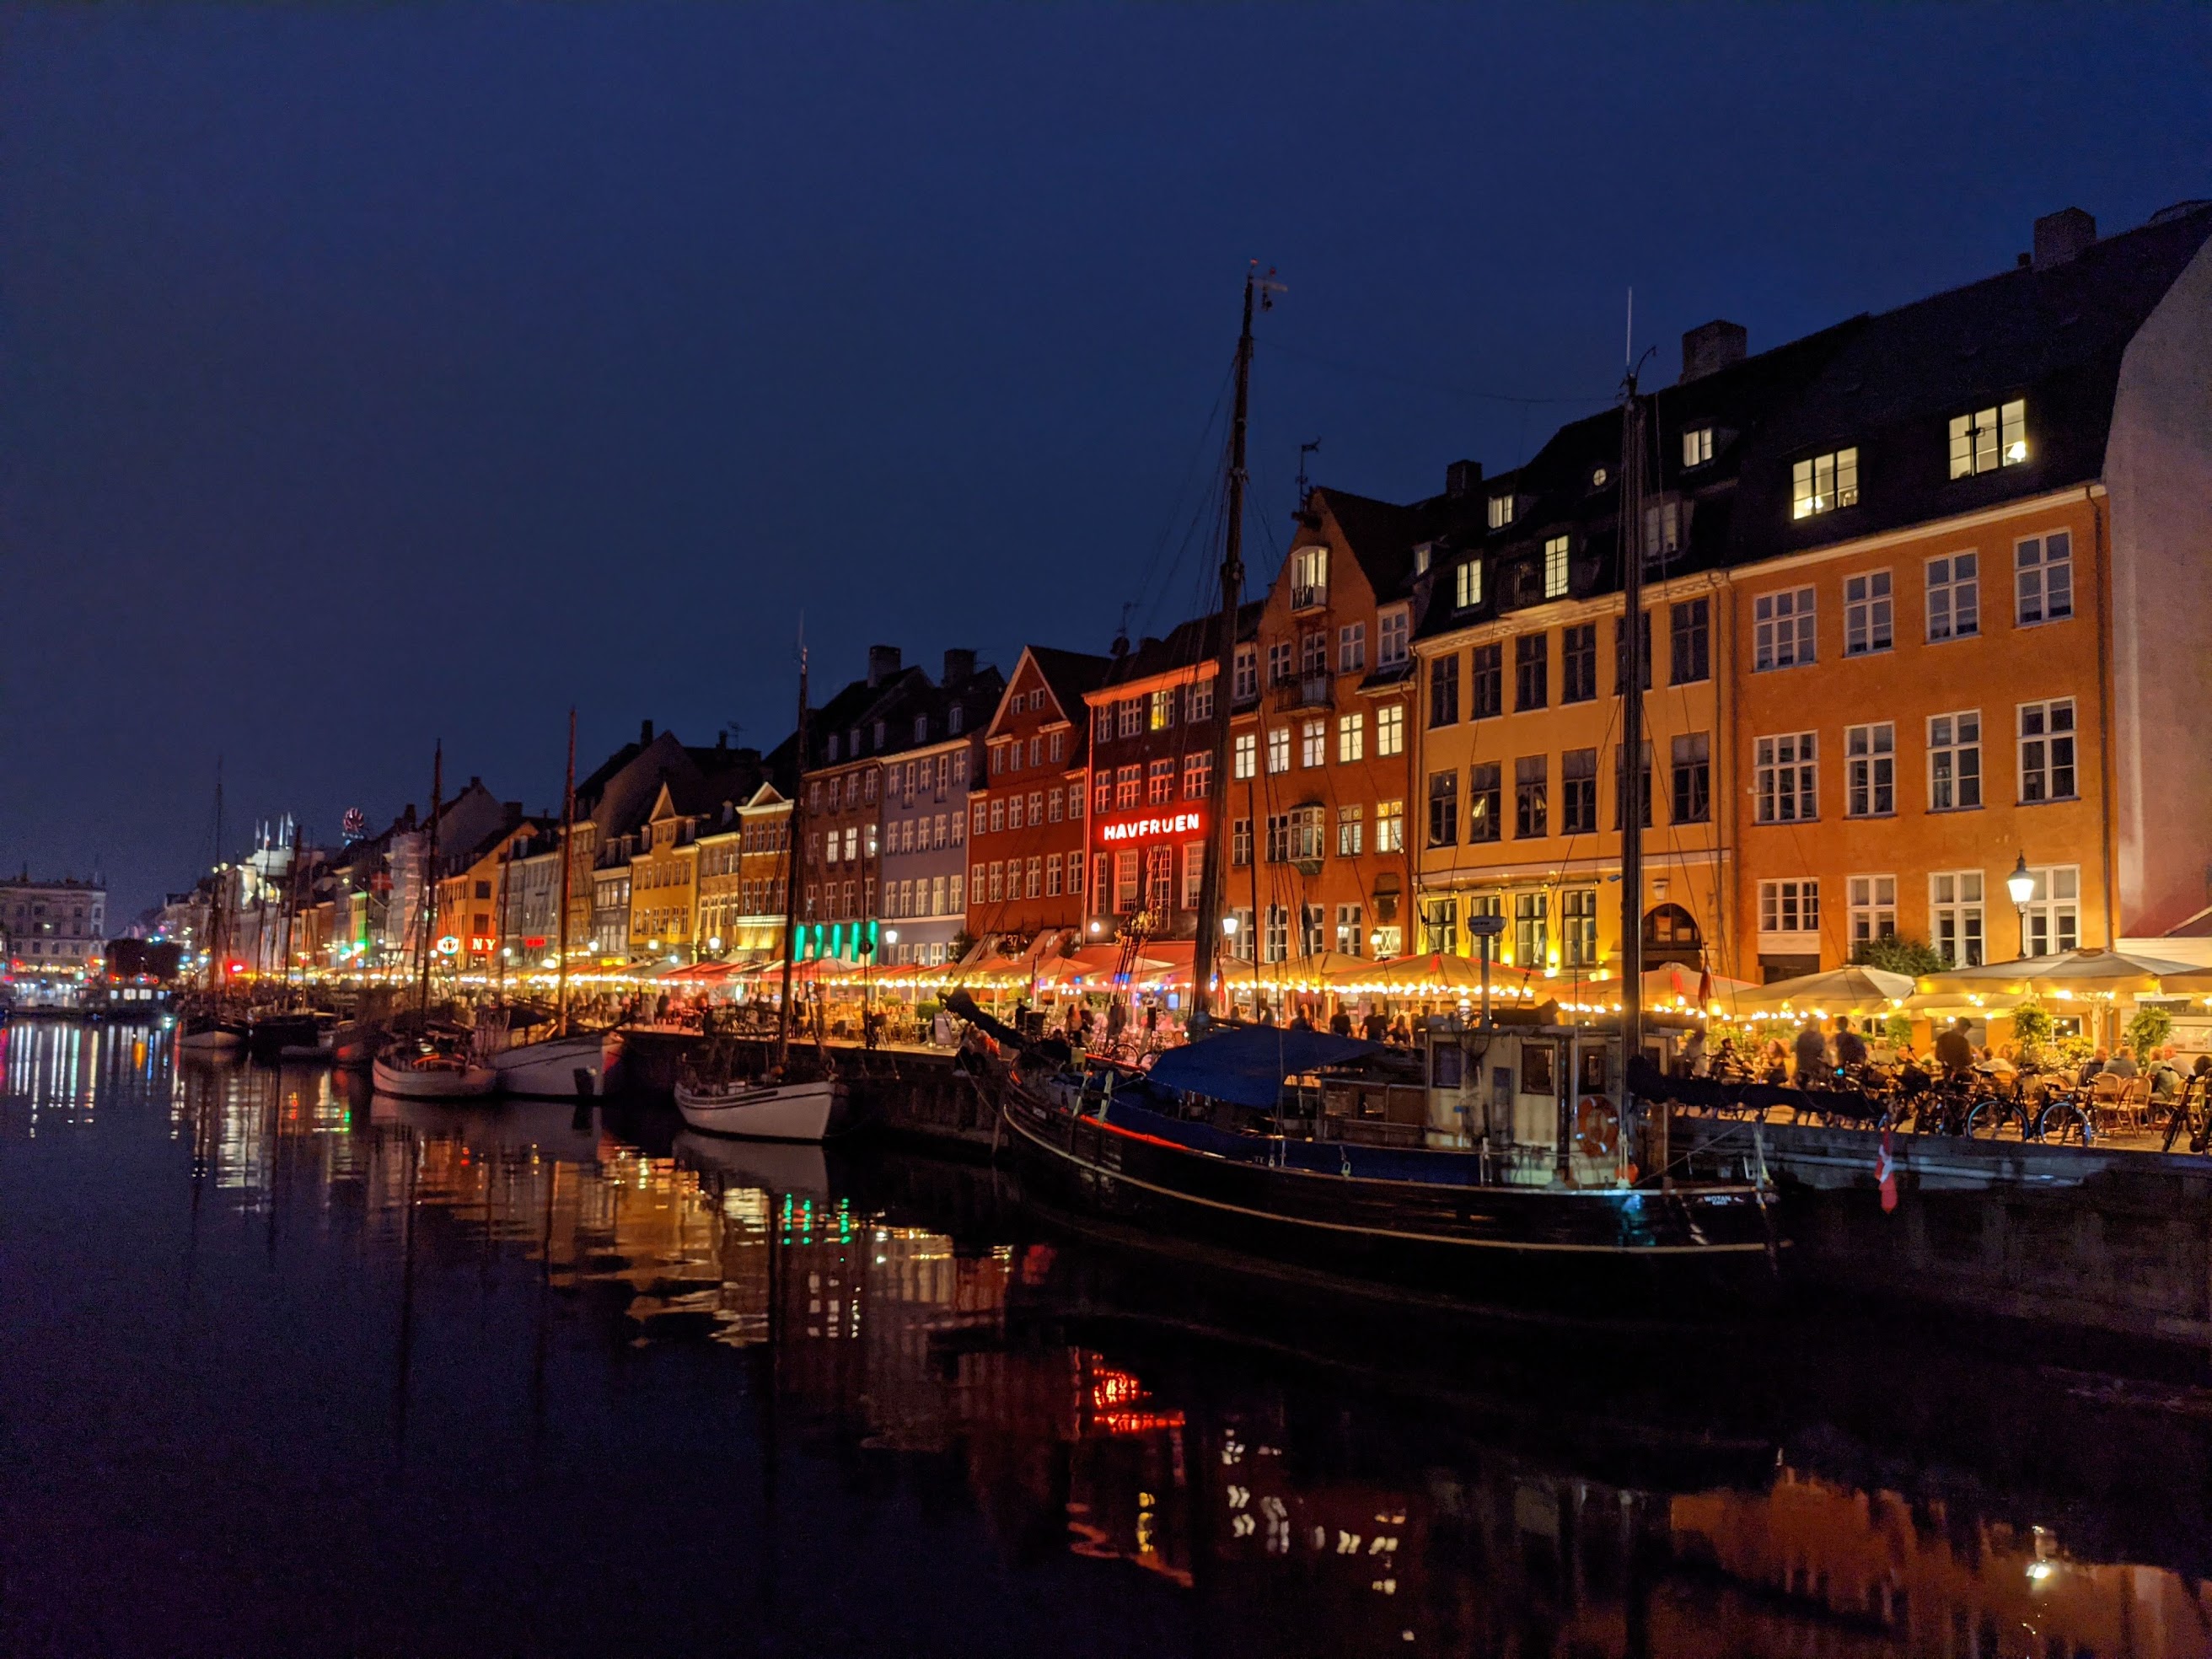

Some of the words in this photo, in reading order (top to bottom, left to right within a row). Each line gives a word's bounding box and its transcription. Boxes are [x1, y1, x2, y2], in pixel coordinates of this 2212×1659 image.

[1103, 813, 1200, 840] HAVFRUEN
[472, 937, 497, 951] NY
[1007, 934, 1019, 947] 37
